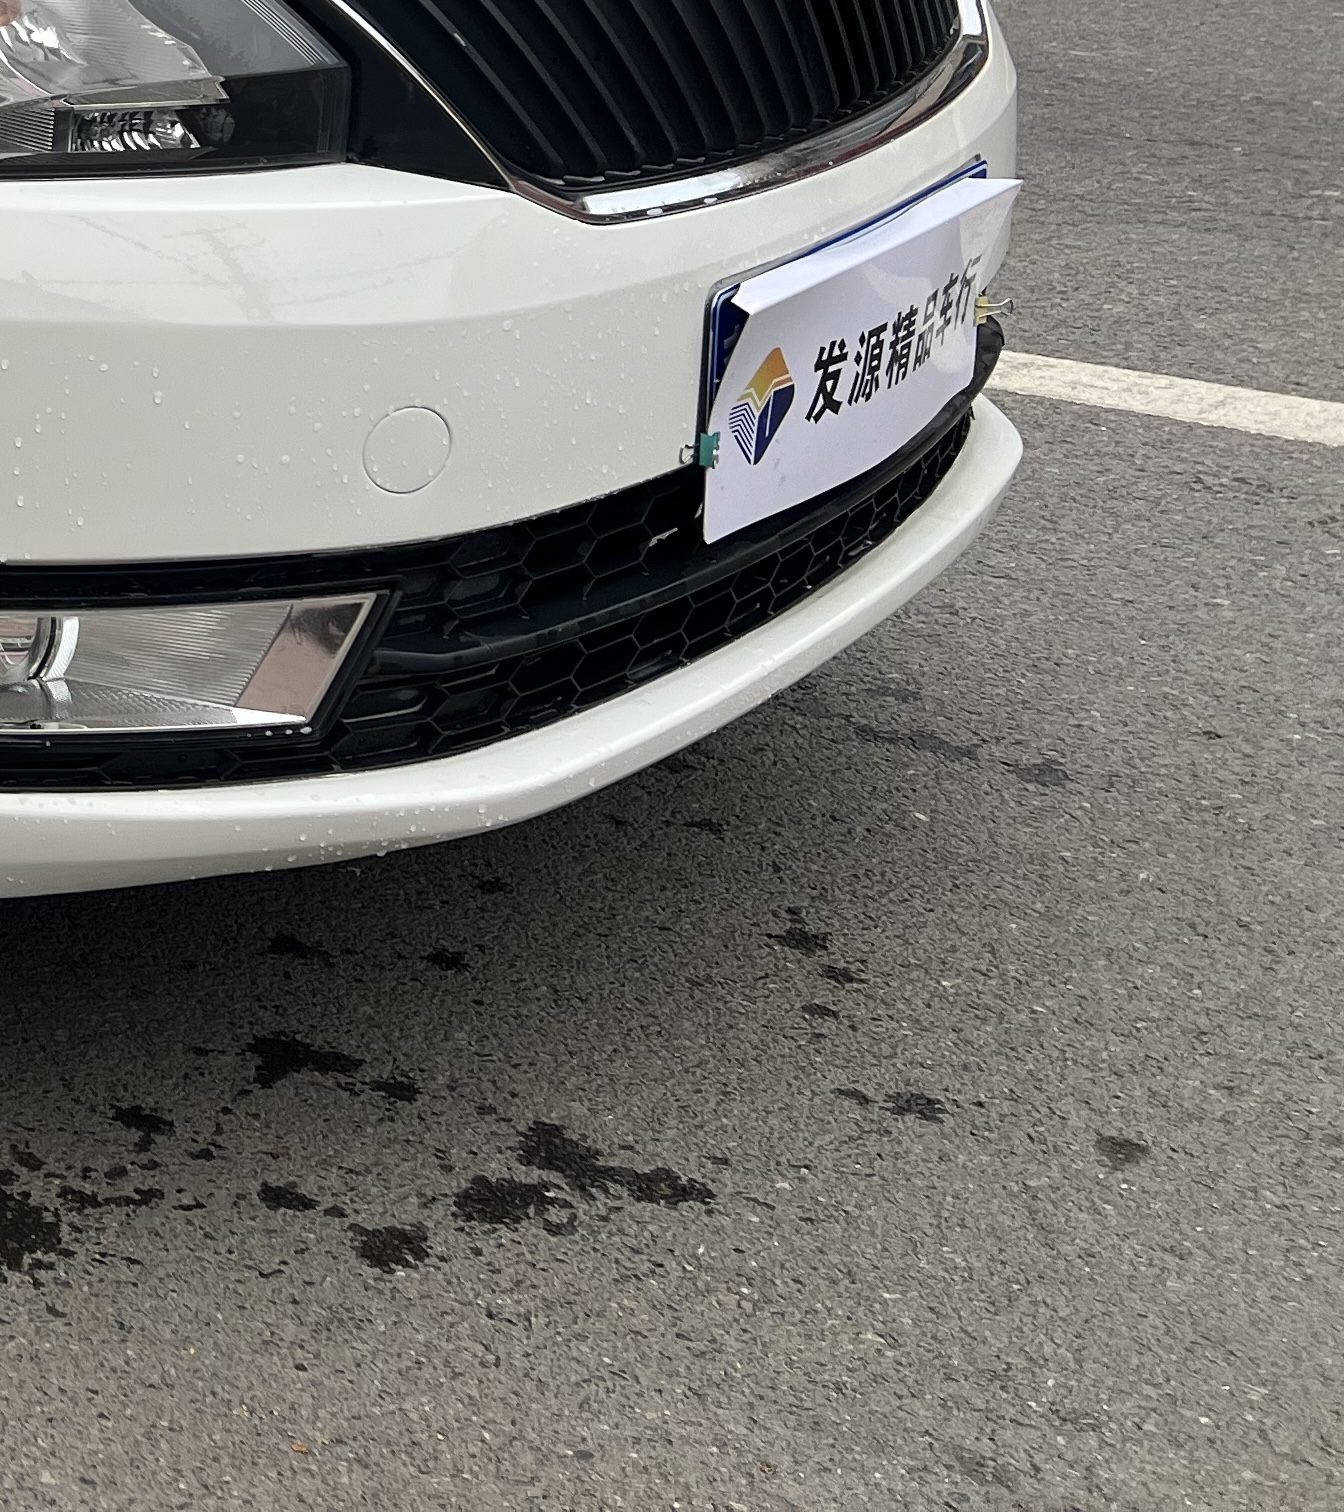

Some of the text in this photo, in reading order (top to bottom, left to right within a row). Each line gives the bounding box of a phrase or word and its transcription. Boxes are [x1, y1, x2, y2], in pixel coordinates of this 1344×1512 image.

[805, 254, 983, 424] 发源精品车行
